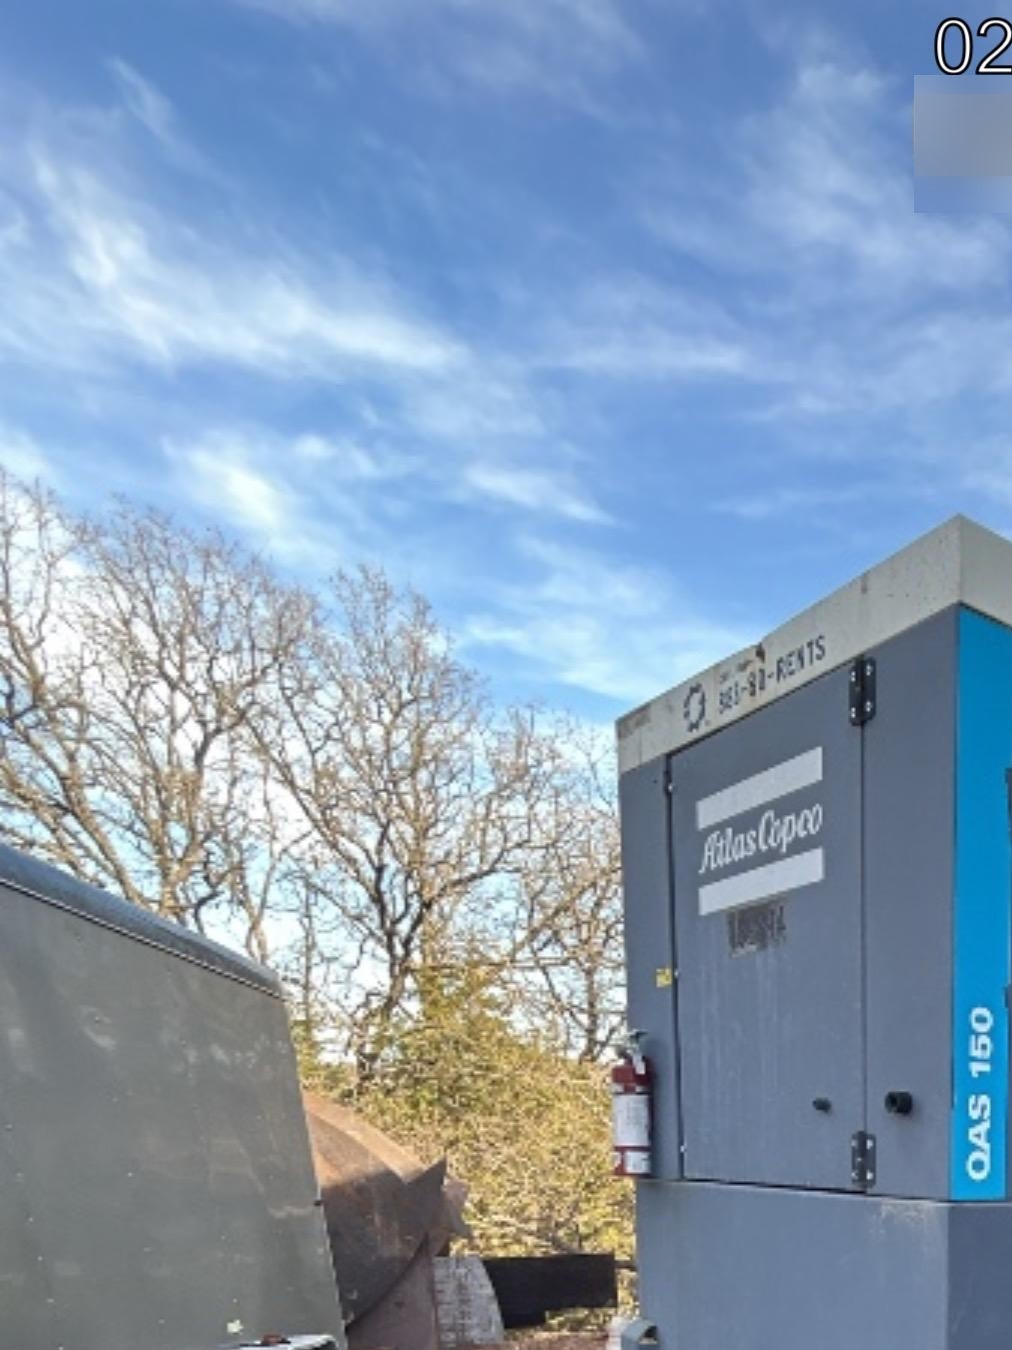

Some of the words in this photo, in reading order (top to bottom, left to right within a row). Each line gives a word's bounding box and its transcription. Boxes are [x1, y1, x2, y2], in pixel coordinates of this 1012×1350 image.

[698, 826, 756, 874] Atlas
[757, 803, 824, 853] Copco
[969, 1006, 994, 1078] 150
